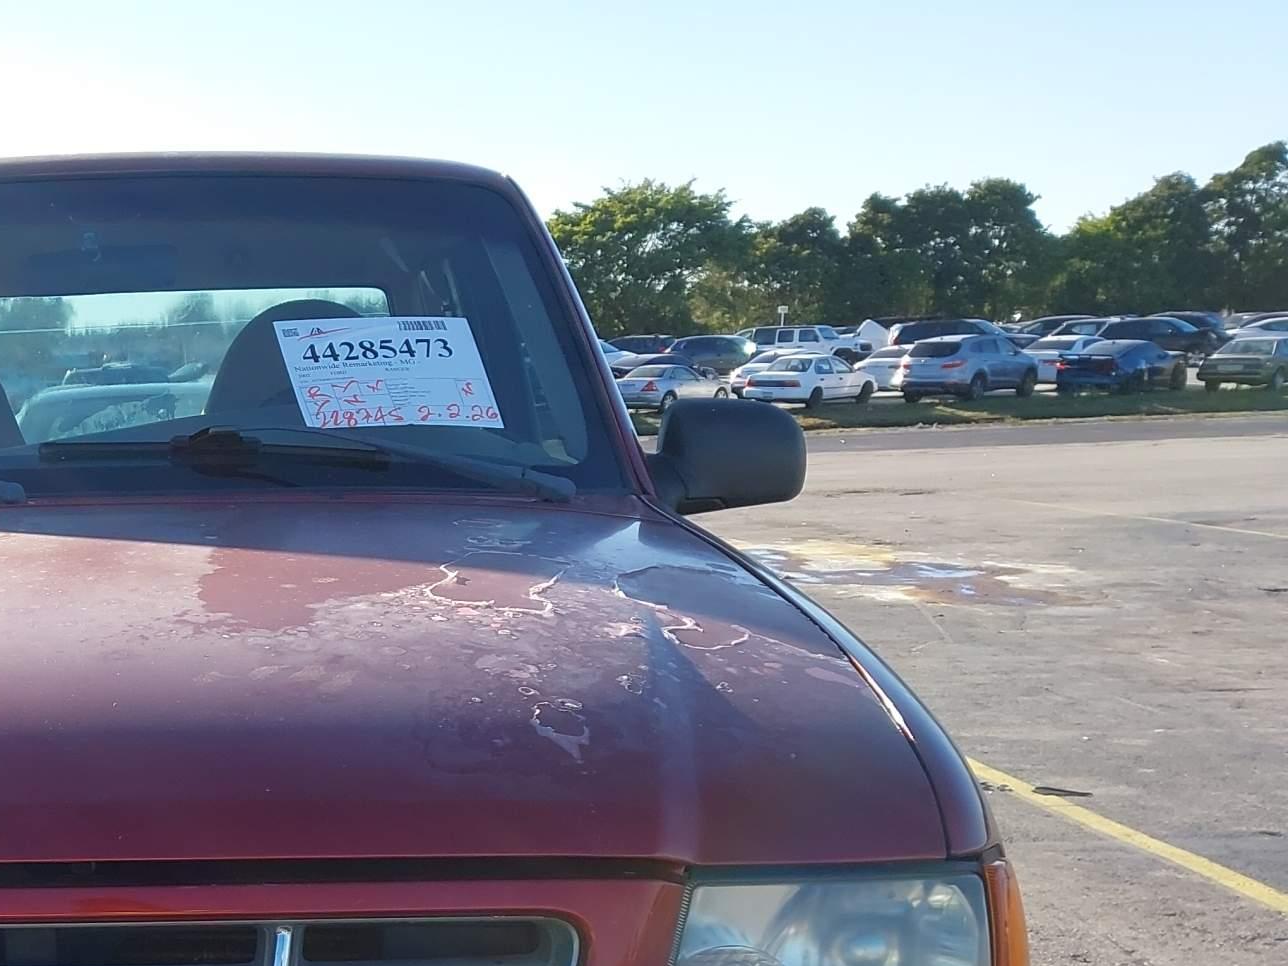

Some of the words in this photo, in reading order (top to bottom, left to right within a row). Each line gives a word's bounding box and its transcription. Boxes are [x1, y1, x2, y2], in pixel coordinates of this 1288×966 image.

[302, 338, 453, 363] 44285473
[294, 362, 341, 372] Nationwide
[342, 360, 393, 369] Remarketing
